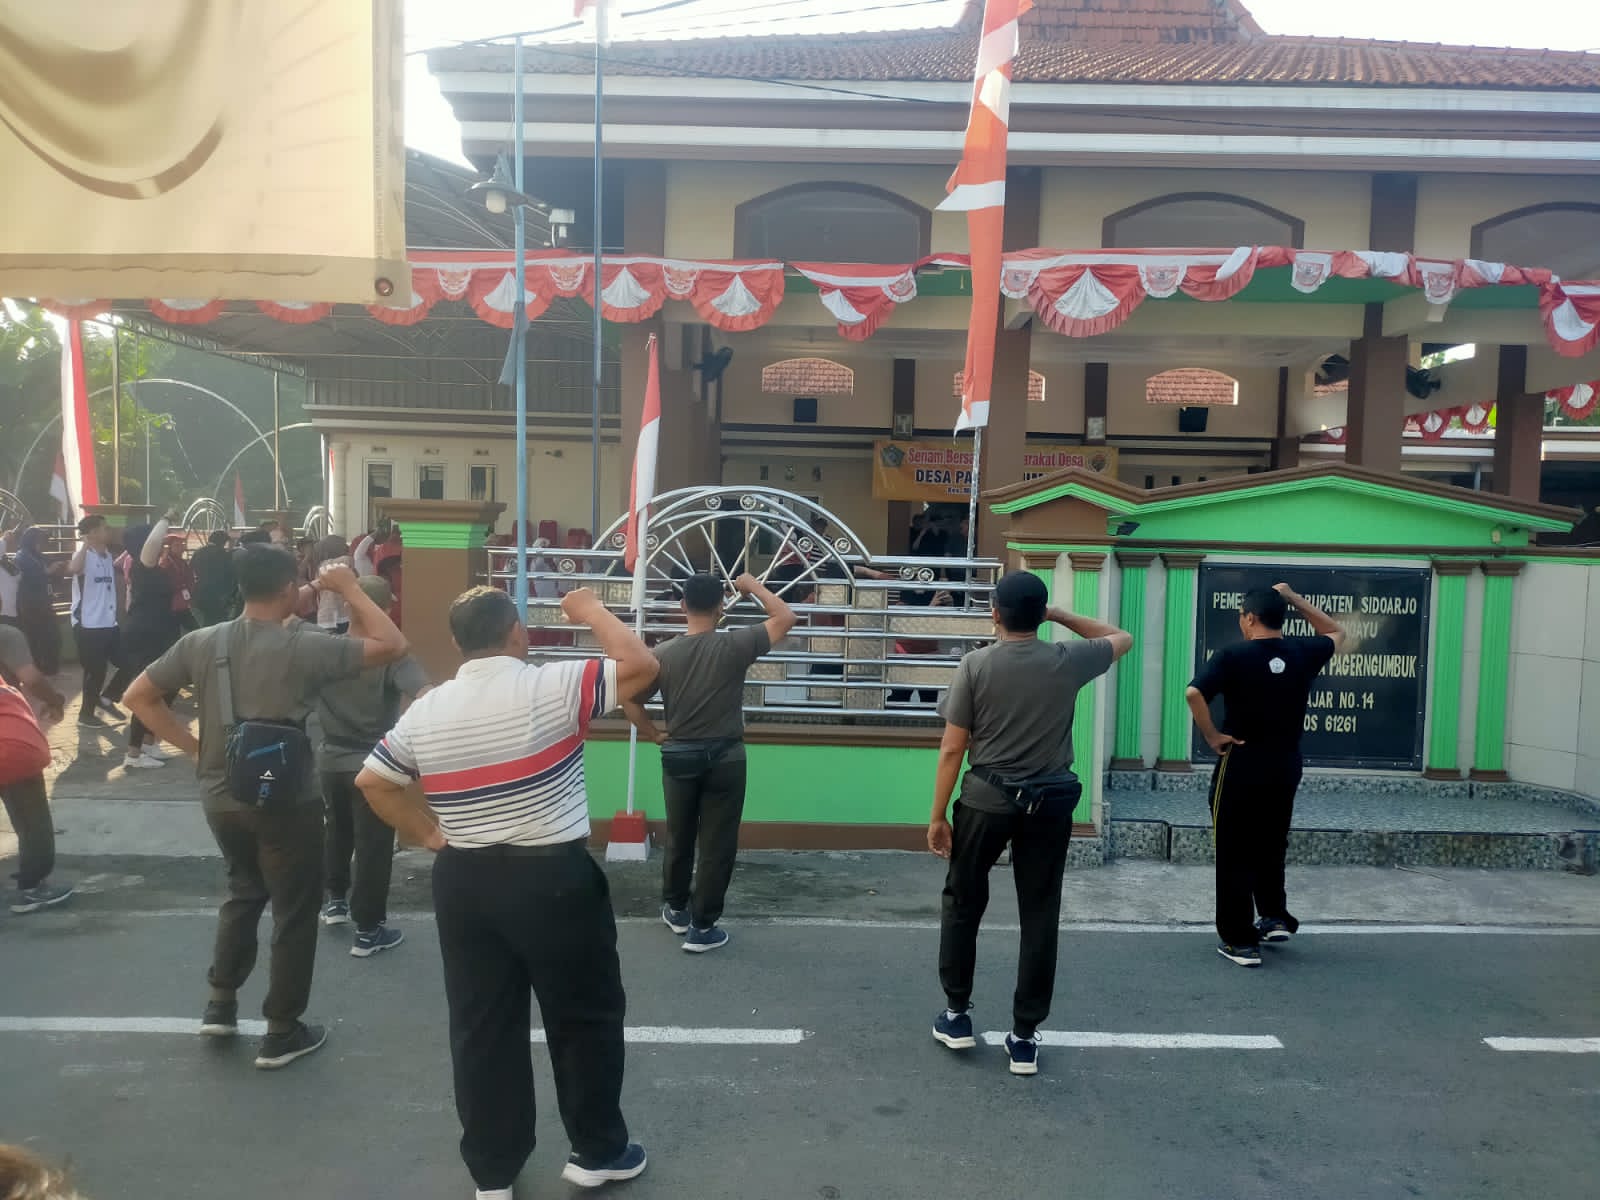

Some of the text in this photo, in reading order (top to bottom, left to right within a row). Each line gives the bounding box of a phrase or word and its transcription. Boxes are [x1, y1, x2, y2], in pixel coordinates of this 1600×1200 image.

[908, 447, 1084, 467] Senam Bersa arakat Desa
[915, 469, 980, 485] DESA PA
[1361, 596, 1417, 615] SIDOARJO
[1282, 618, 1316, 637] MATAN
[1329, 653, 1417, 678] PAGERNGUMBUK
[1306, 691, 1333, 708] AJAR
[1303, 714, 1357, 733] OS 61261
